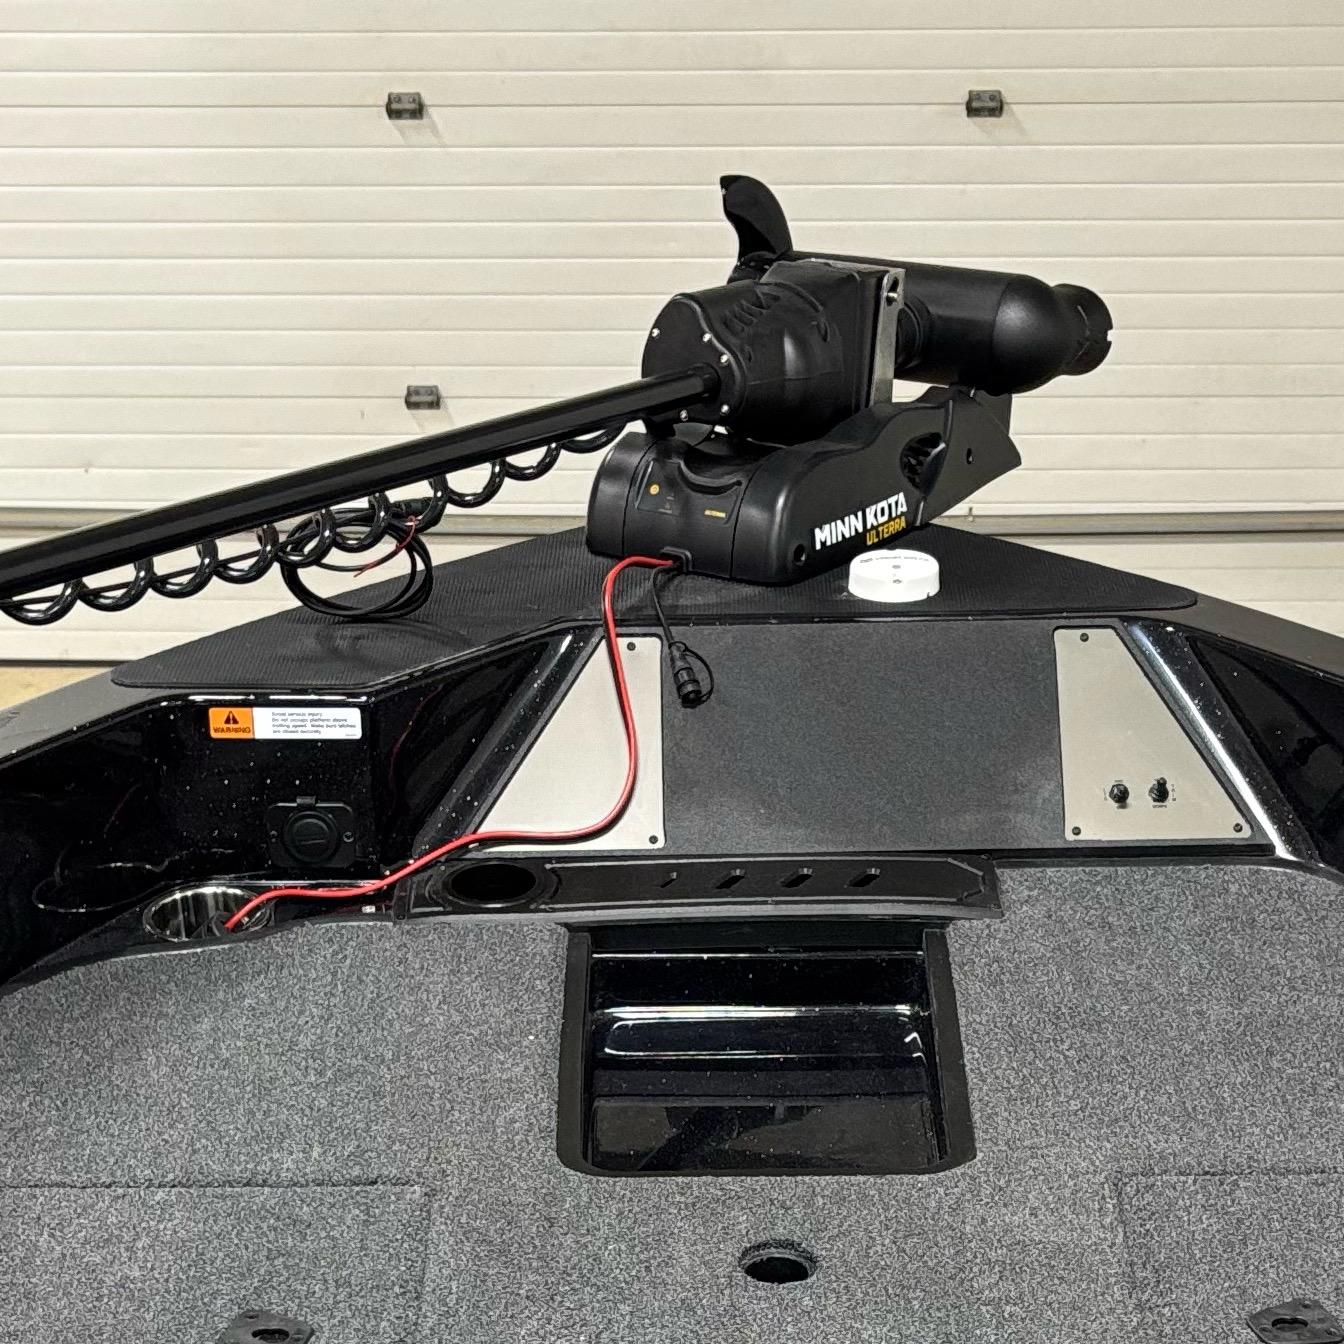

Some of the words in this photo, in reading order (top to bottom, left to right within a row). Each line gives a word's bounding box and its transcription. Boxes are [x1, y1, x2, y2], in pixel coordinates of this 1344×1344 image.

[814, 511, 864, 551] MINN
[865, 491, 908, 530] KOTA
[866, 516, 907, 546] ULTERRA
